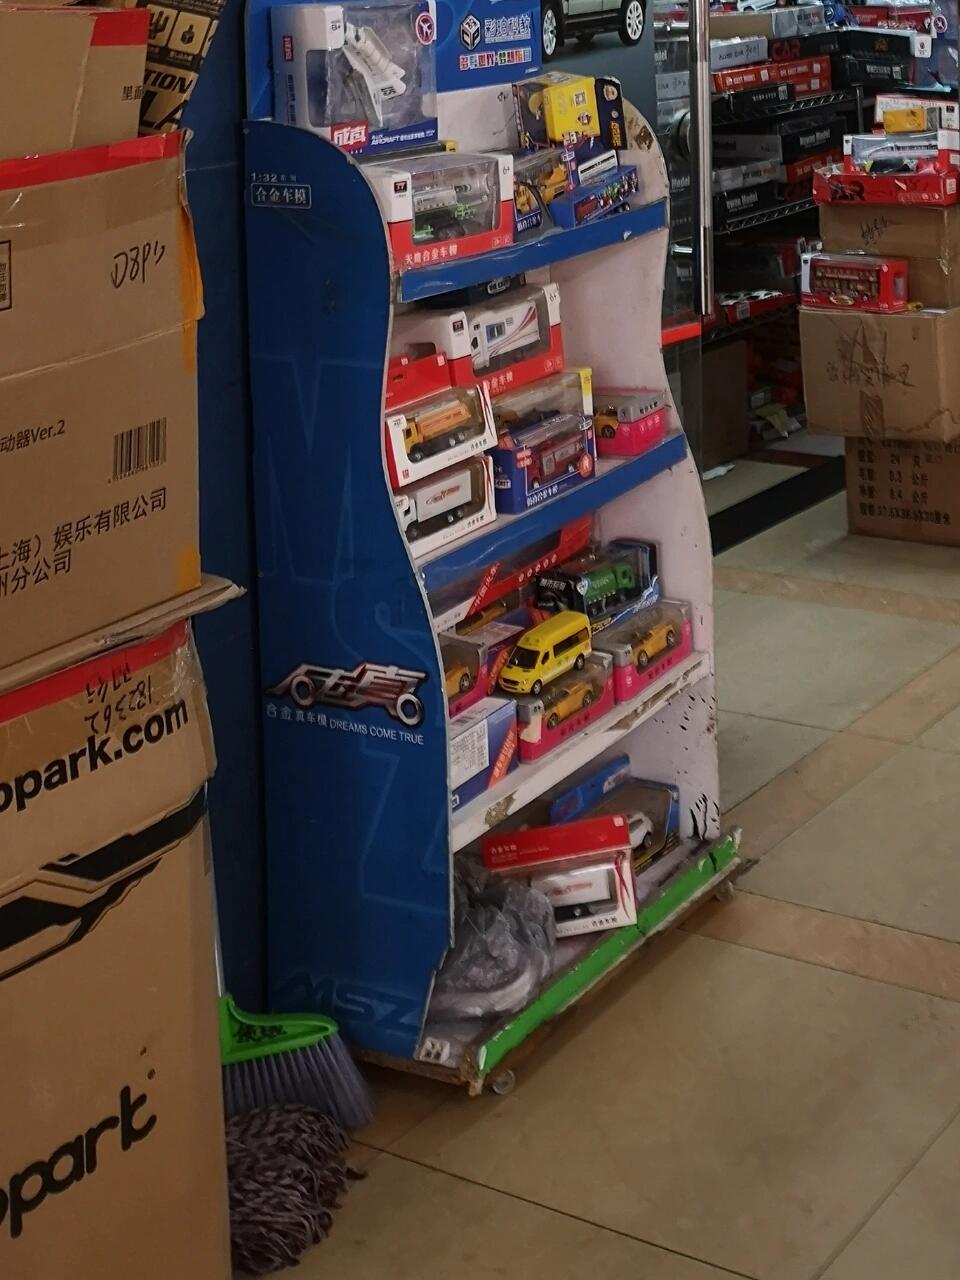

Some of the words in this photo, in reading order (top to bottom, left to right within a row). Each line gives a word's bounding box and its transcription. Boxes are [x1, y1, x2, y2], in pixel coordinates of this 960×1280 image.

[329, 719, 368, 736] DREAMS
[369, 725, 397, 741] COME
[399, 731, 424, 746] TRUE
